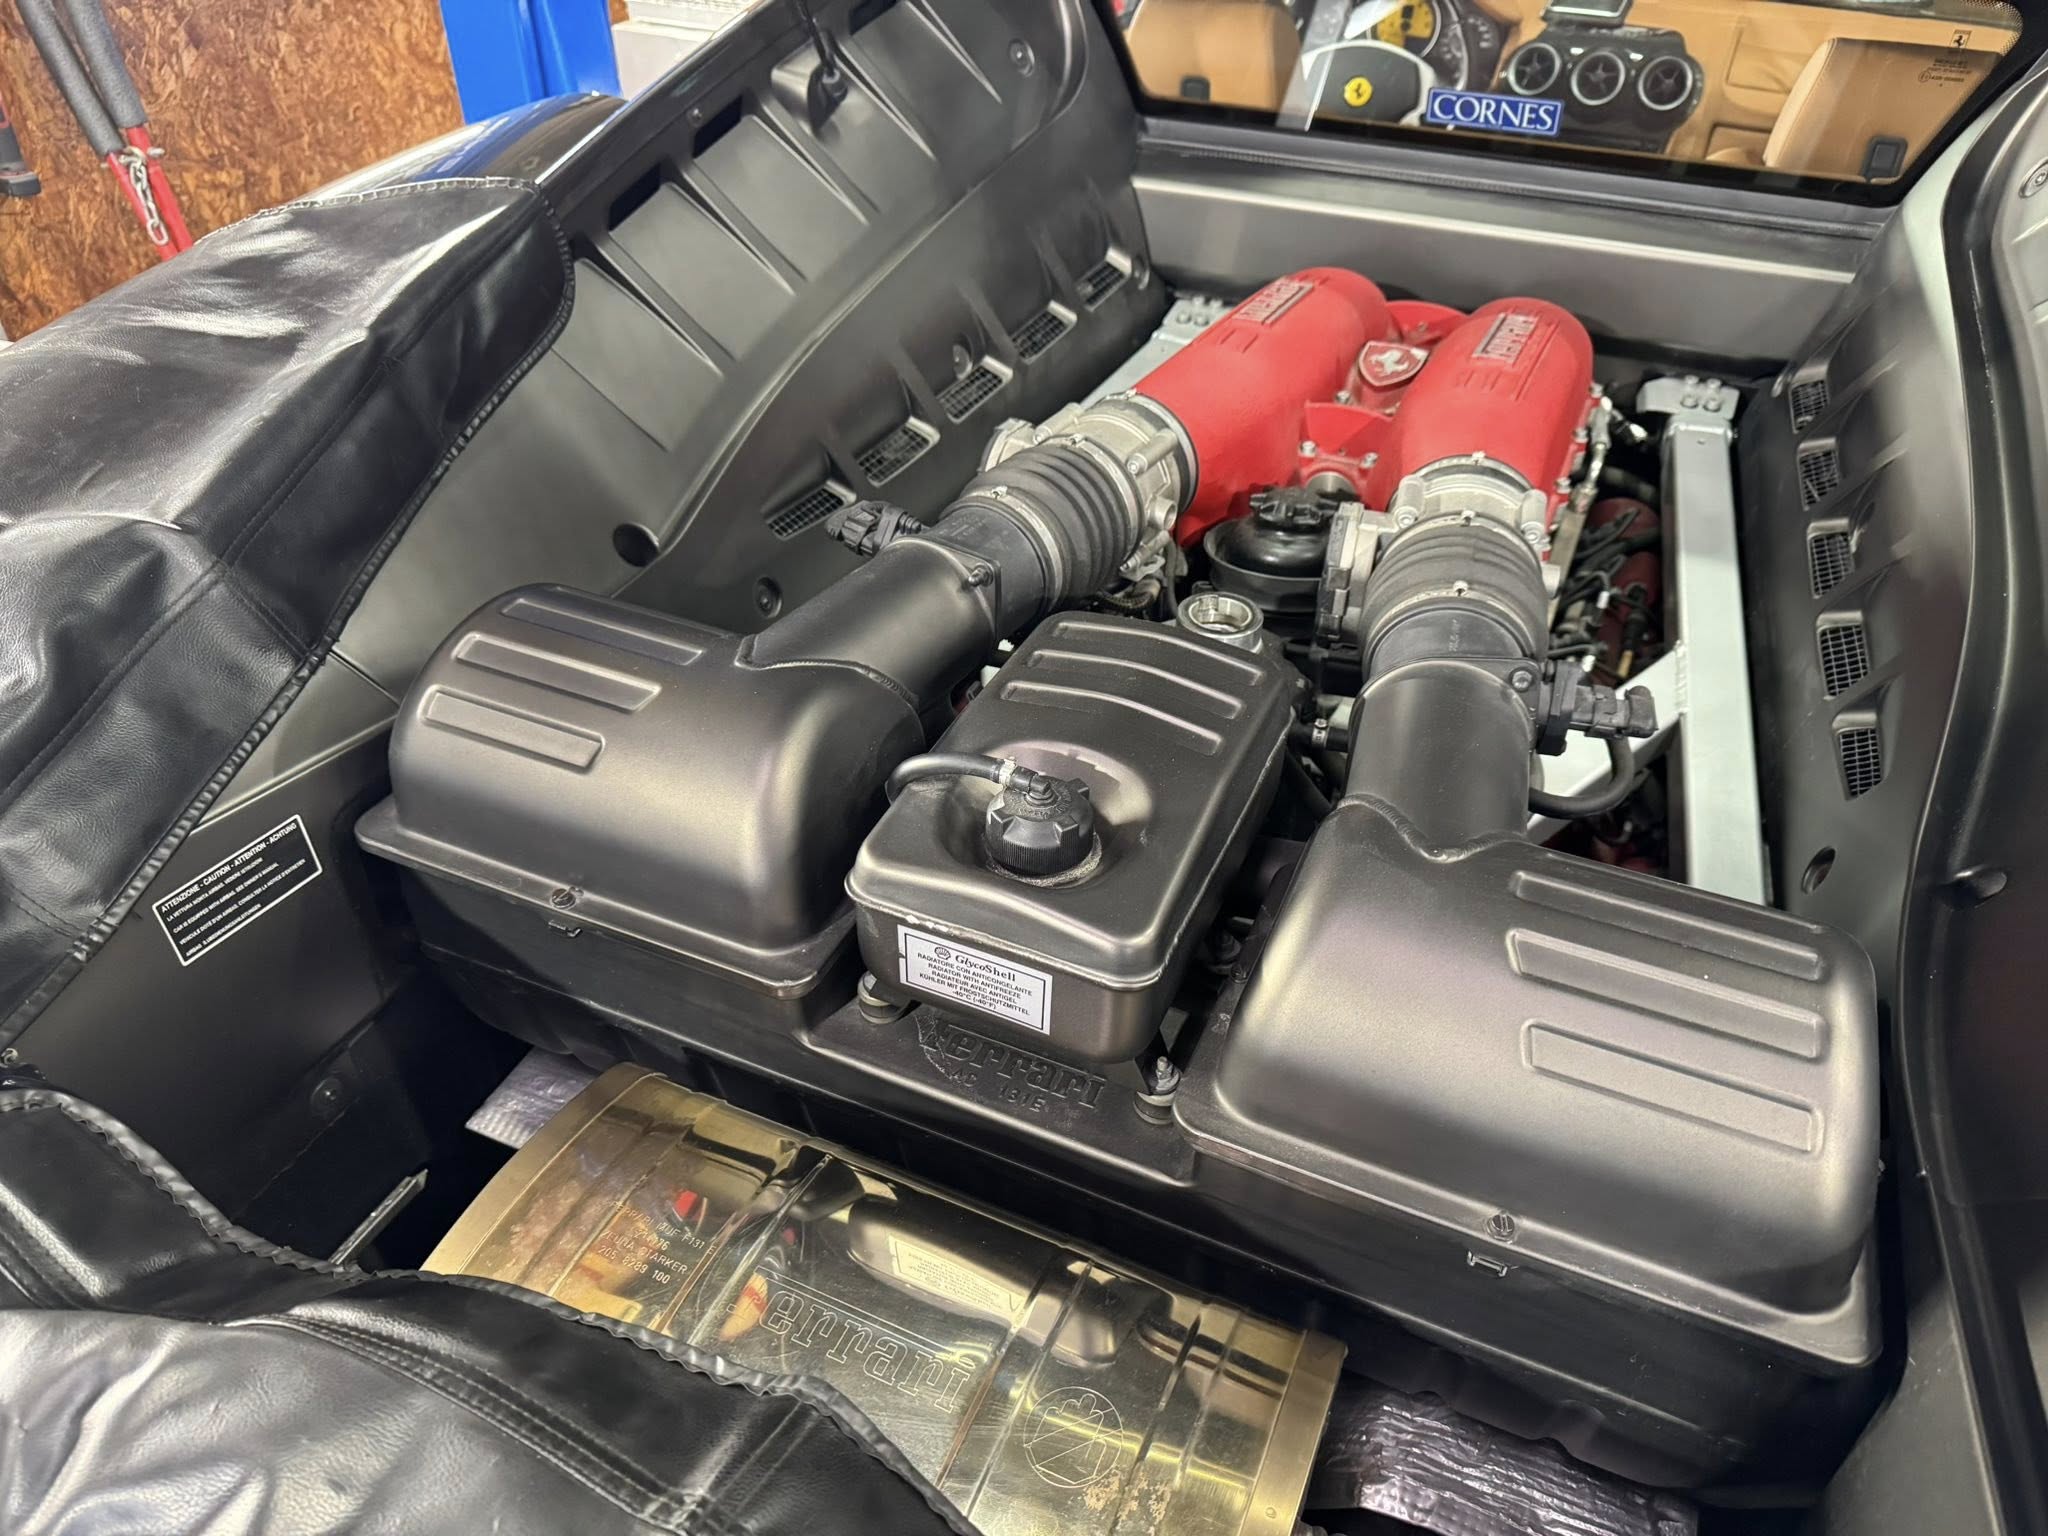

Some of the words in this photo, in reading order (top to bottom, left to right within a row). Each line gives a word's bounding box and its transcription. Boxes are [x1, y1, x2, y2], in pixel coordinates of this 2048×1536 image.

[1432, 93, 1555, 131] CORNES
[161, 885, 199, 912] ATTENZIONE
[203, 866, 230, 885] CAUTION
[233, 843, 265, 865] ATTENTION
[269, 823, 296, 843] ACHTUNG
[918, 953, 954, 968] RADIATORE
[957, 966, 970, 974] CON
[973, 971, 1032, 995] ANTICONGELANTE
[929, 963, 960, 977] RADIATOR
[963, 975, 979, 983] WITH
[981, 981, 1020, 998] ANTIFREEZE
[956, 954, 1015, 981] GlycoShell
[920, 972, 945, 985] KÜHLER
[960, 987, 1029, 1014] FROSTSCHUTZMITTEL
[932, 971, 968, 986] RADIATEUR
[971, 984, 987, 992] AVEC
[989, 990, 1016, 1003] ANTIGEL
[598, 1245, 617, 1260] 205
[652, 1269, 671, 1284] 100
